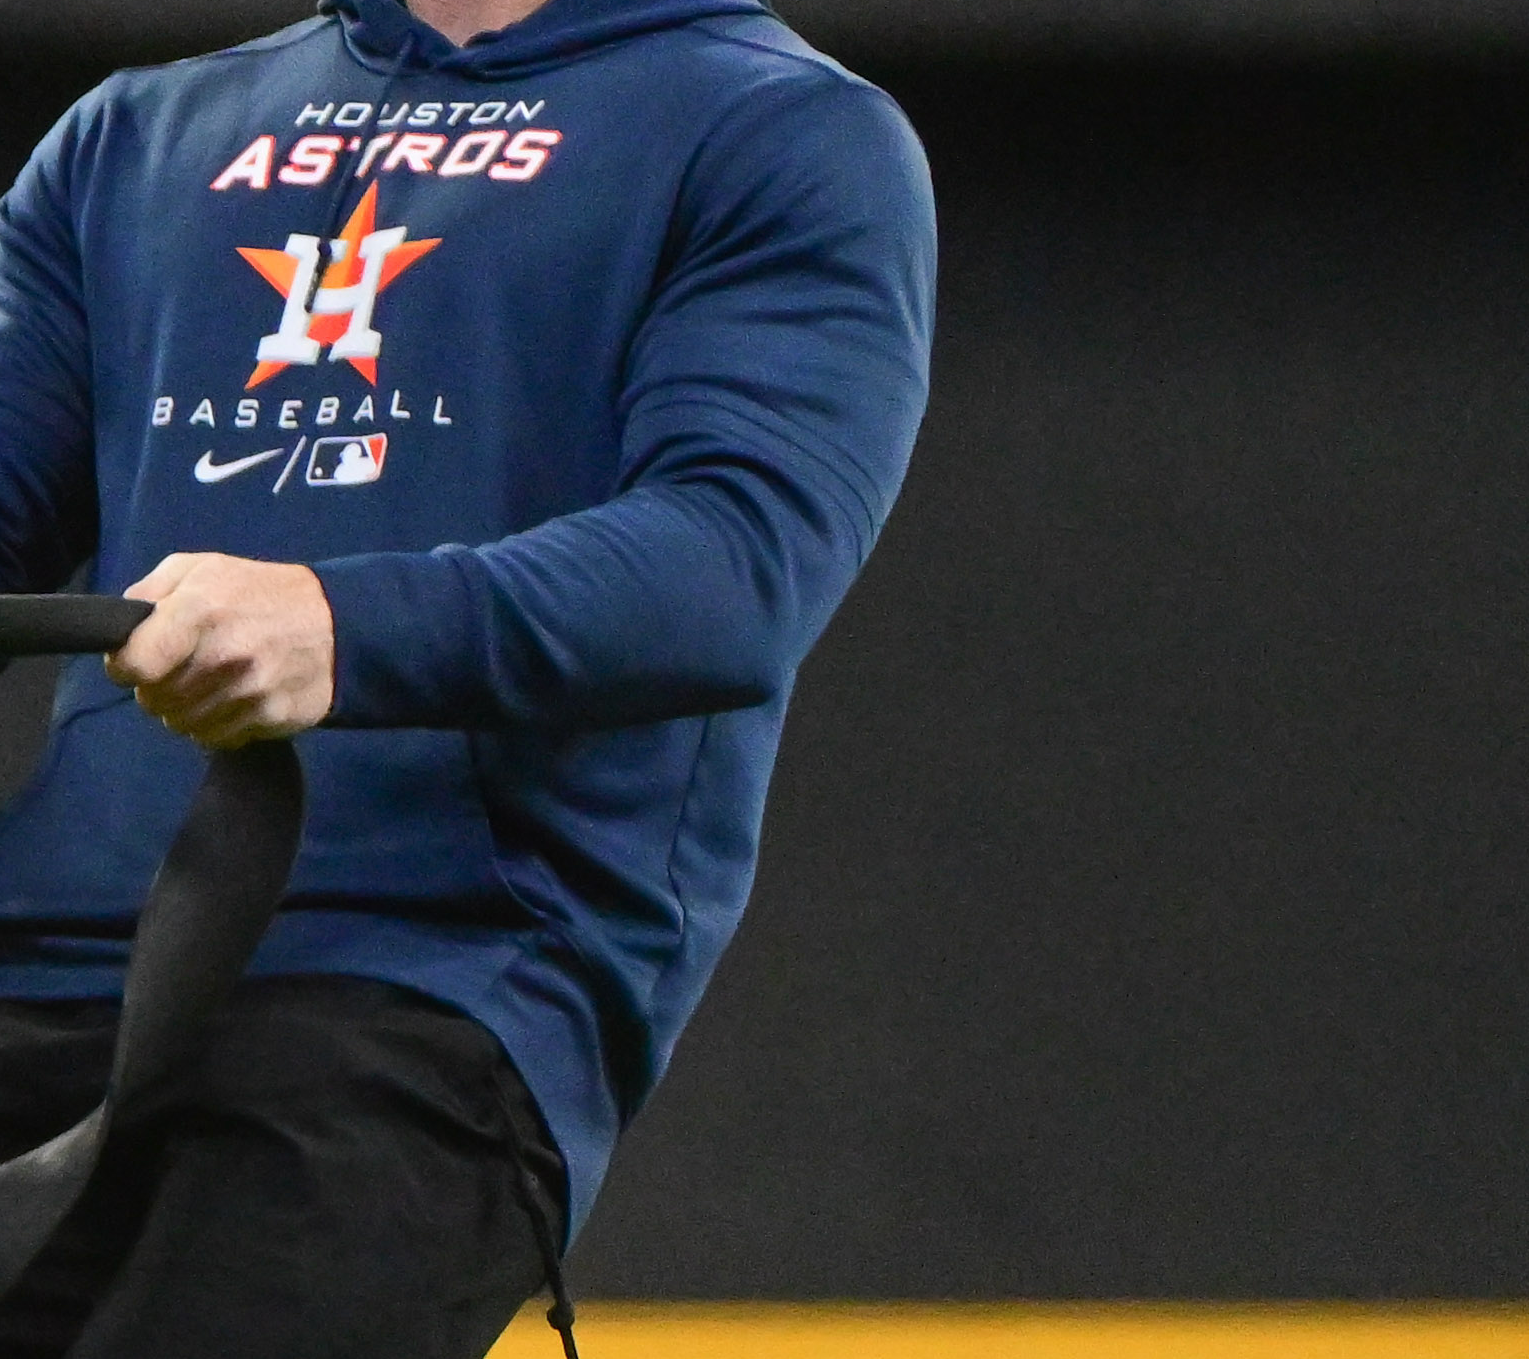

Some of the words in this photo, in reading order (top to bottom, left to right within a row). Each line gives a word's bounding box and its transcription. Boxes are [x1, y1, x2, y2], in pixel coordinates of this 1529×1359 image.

[293, 99, 546, 128] HOUSTON
[209, 126, 563, 191] ASTROS
[255, 225, 408, 366] H
[151, 389, 453, 429] BASEBALL
